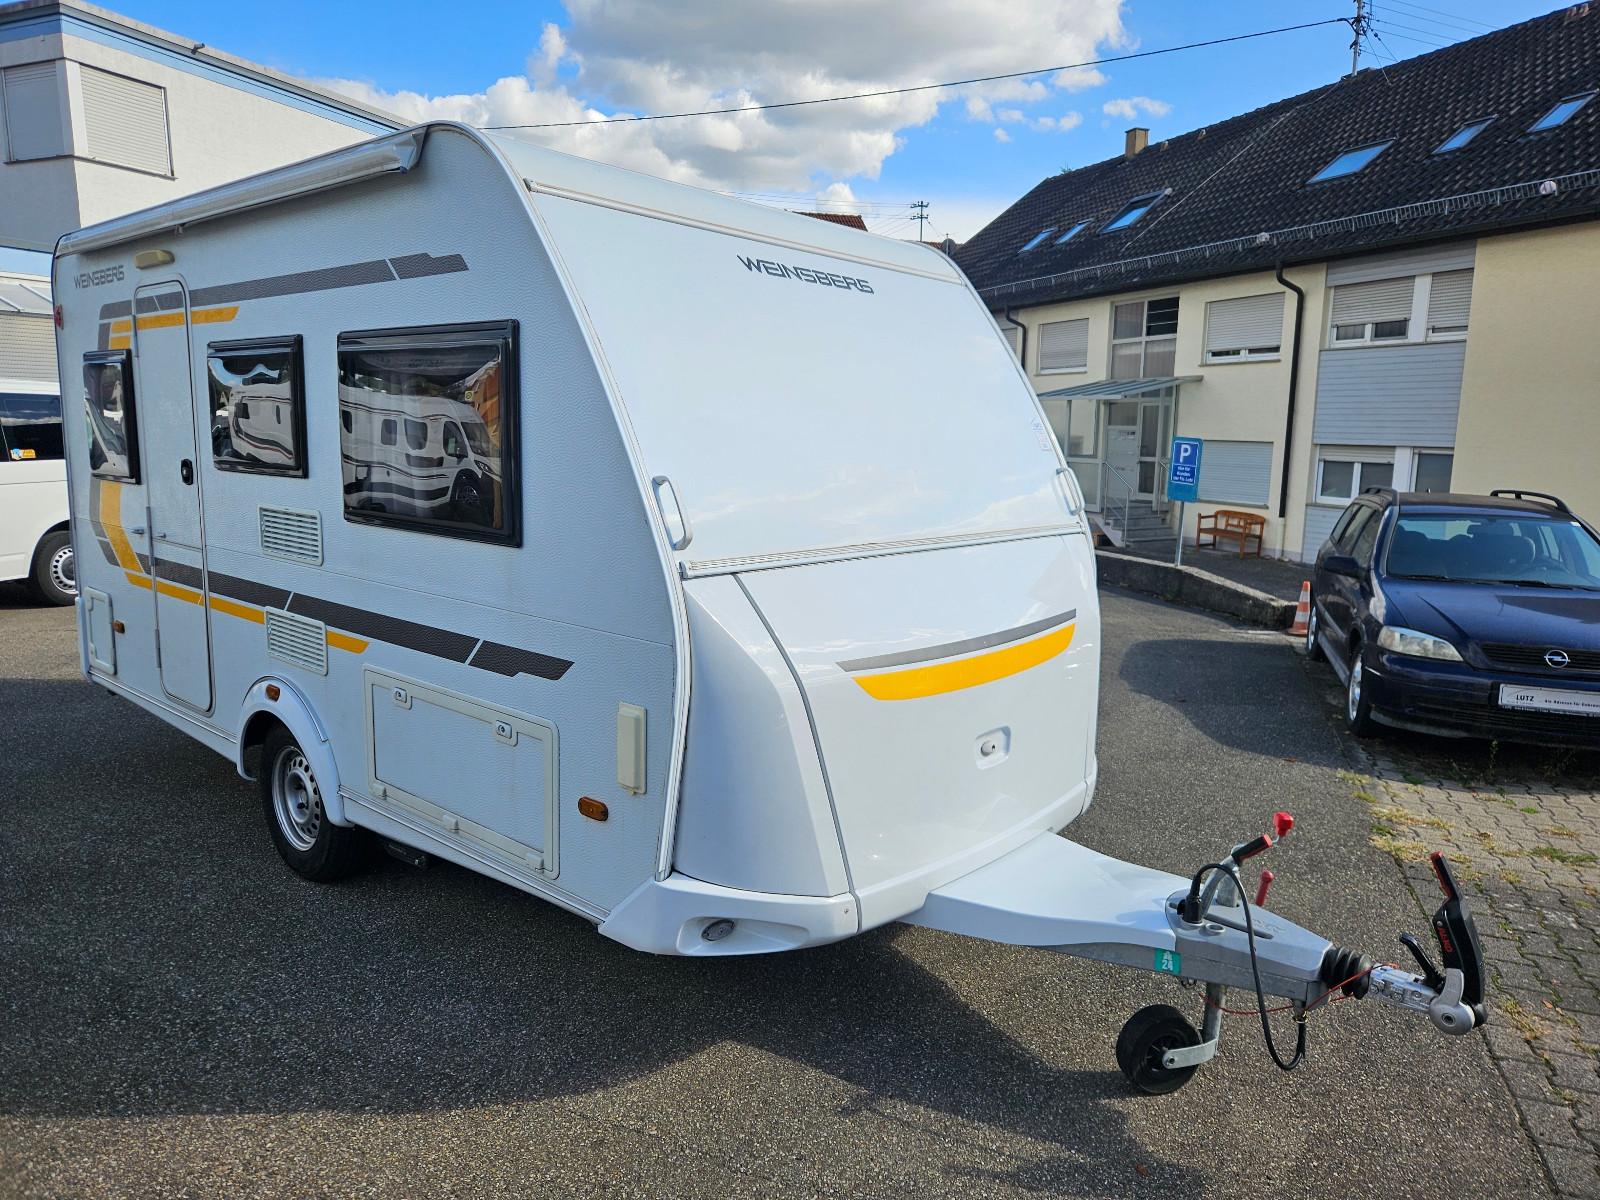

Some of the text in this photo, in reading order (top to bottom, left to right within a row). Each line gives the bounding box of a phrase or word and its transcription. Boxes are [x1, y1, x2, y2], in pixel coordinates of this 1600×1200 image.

[73, 264, 125, 289] WEINSBERG
[737, 254, 875, 295] WEINSBERG
[1180, 444, 1191, 463] P
[1516, 694, 1535, 702] LUTZ
